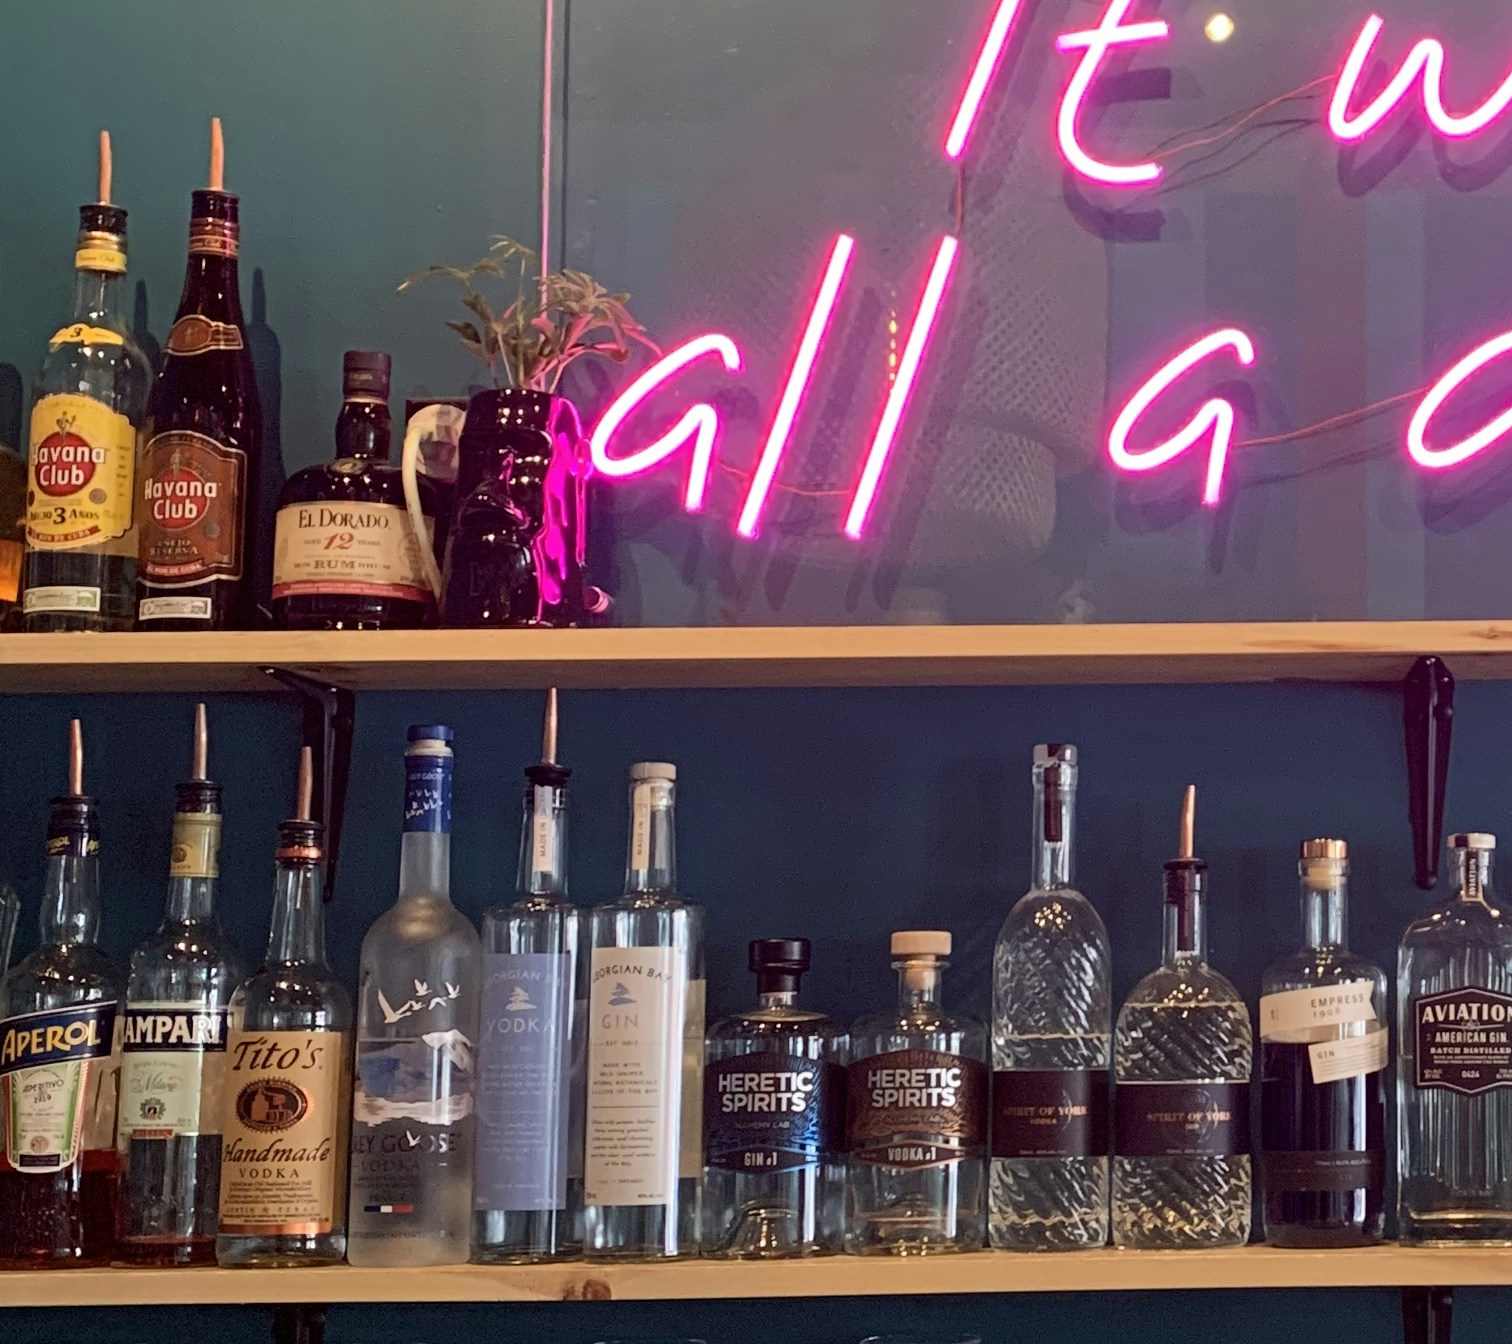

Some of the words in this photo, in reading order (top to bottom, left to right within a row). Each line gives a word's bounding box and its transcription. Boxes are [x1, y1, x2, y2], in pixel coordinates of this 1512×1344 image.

[582, 233, 960, 541] all
[1107, 327, 1257, 506] a
[39, 465, 85, 486] Club
[145, 478, 217, 500] Havana
[53, 507, 66, 525] 3
[154, 499, 197, 520] Club
[298, 509, 316, 529] EL
[319, 508, 389, 530] DORADO
[323, 532, 354, 550] 12
[313, 559, 356, 569] RUM
[1310, 993, 1365, 1009] EMPRESS
[118, 1014, 222, 1044] AMPARI
[601, 1014, 639, 1030] GIN
[0, 1018, 101, 1067] APEROL
[1434, 1031, 1487, 1044] AMERICAN
[232, 1036, 324, 1071] Tito's
[1316, 1050, 1335, 1059] GIN
[1429, 1046, 1461, 1055] BATCH
[1463, 1046, 1512, 1055] DISTILLED
[718, 1071, 814, 1092] HERETIC
[867, 1067, 962, 1089] HERETIC
[721, 1092, 807, 1113] SPIRITS
[871, 1087, 956, 1108] SPIRITS
[1039, 1106, 1056, 1116] OF
[1187, 1112, 1203, 1121] OF
[222, 1137, 331, 1164] Handmade
[744, 1151, 764, 1166] GIN
[887, 1147, 924, 1161] VODKA
[239, 1167, 300, 1180] VODKA
